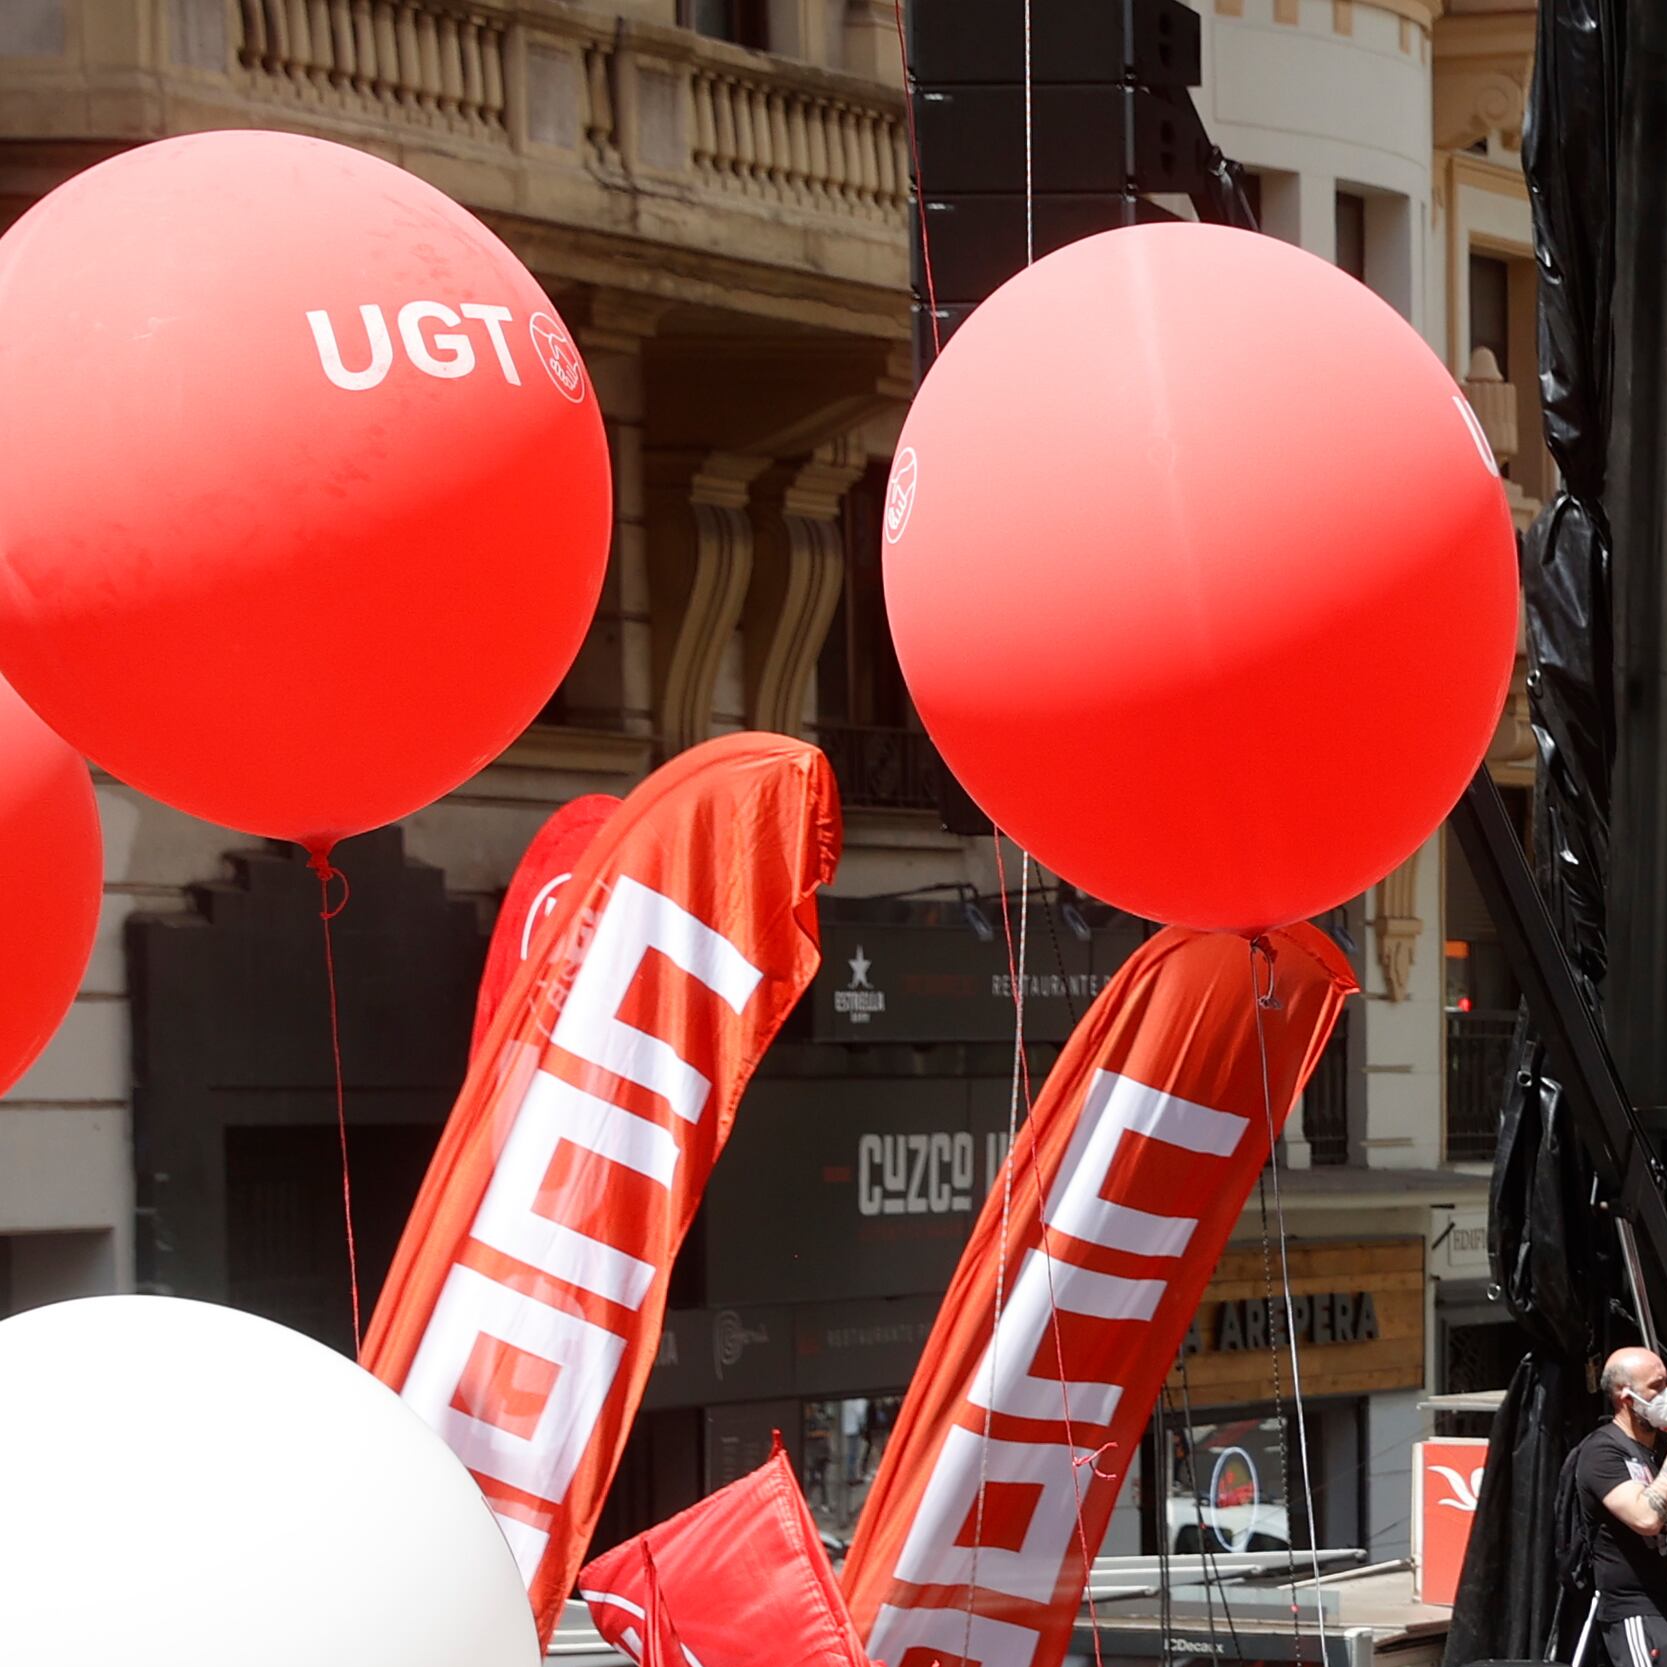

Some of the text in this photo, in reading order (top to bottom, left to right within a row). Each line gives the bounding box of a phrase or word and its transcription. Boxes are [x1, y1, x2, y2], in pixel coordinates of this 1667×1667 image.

[307, 300, 522, 391] UGT
[858, 1132, 974, 1217] CUZCO
[1217, 1291, 1379, 1351] AREPERA
